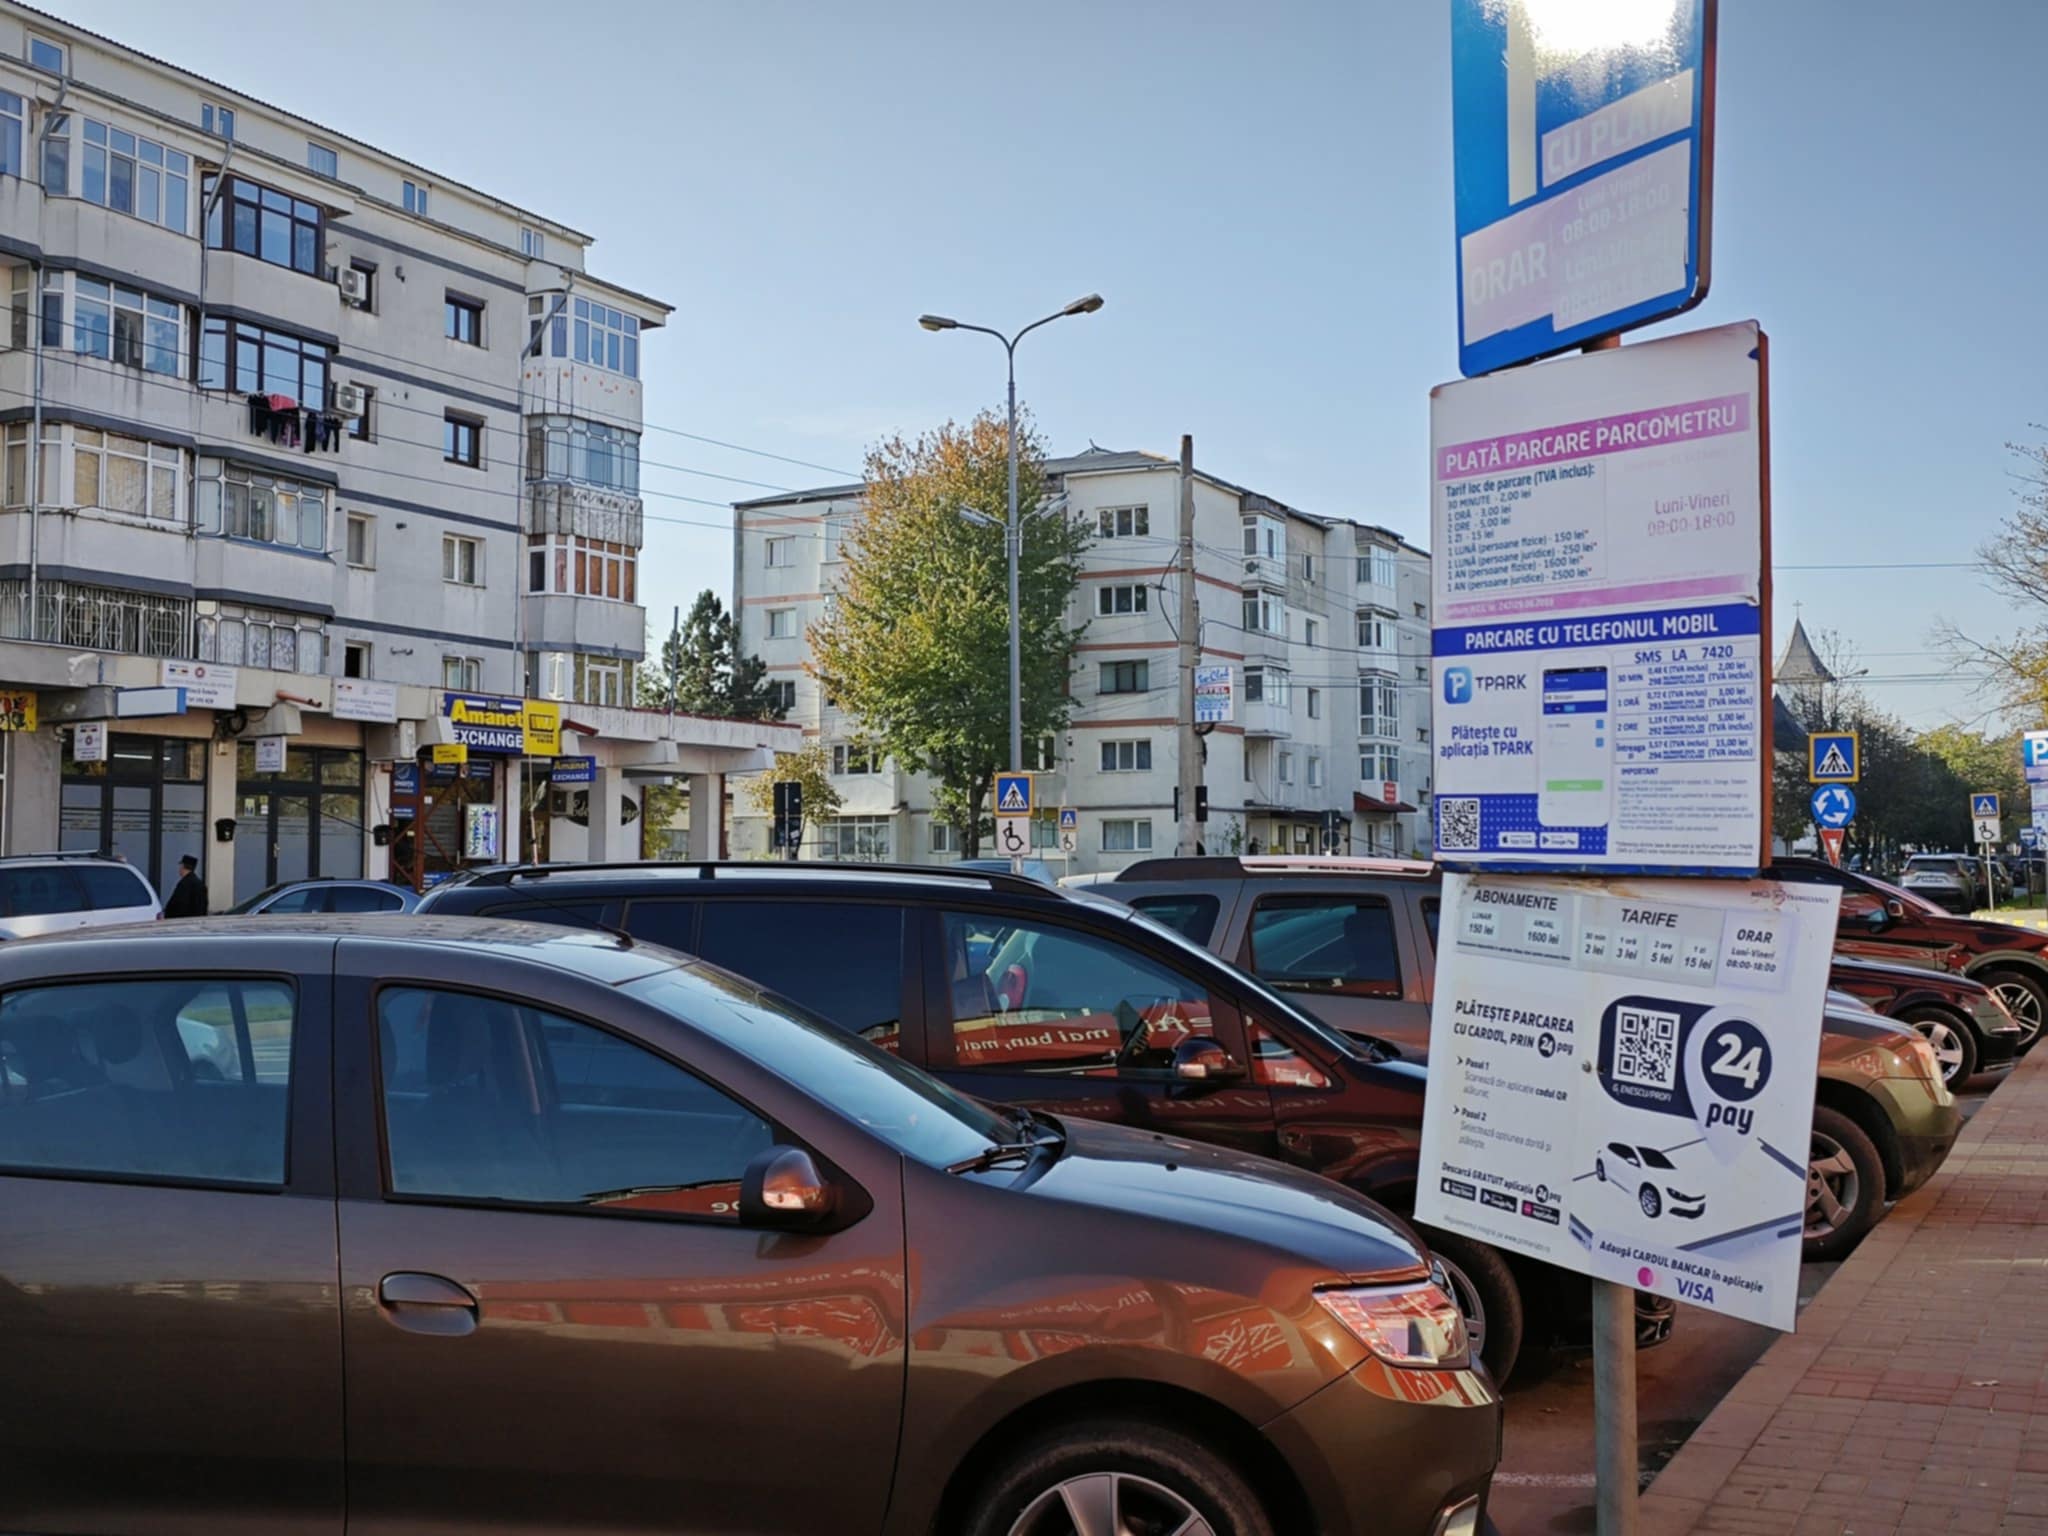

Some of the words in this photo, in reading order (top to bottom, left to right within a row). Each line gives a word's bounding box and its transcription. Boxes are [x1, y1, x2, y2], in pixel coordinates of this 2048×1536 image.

[1548, 132, 1581, 175] CU
[1470, 241, 1548, 306] ORAR
[1446, 441, 1500, 473] PLATĂ
[1504, 430, 1591, 464] PARCARE
[1595, 404, 1737, 449] PARCOMETRU
[1446, 483, 1466, 497] Tarif
[1468, 482, 1481, 494] loc
[1483, 479, 1495, 491] de
[1497, 474, 1532, 492] parcare
[1534, 470, 1557, 486] (TVA
[1559, 463, 1595, 480] inclus):
[1460, 494, 1490, 508] MINUTE
[1521, 489, 1532, 499] lei
[1654, 490, 1730, 515] Luni-Vineri
[1501, 504, 1512, 514] lei
[1454, 521, 1471, 532] ORE
[1500, 516, 1511, 526] lei
[1648, 511, 1735, 536] 08:00-18:00
[1471, 530, 1482, 540] 15
[1484, 528, 1495, 539] lei
[1478, 538, 1519, 554] (persoane
[1554, 531, 1572, 543] 150
[1478, 551, 1519, 567] (persoane
[1468, 564, 1509, 579] (persoane
[1468, 576, 1509, 591] (persoane
[1465, 628, 1534, 650] PARCARE
[1538, 626, 1559, 645] CU
[1563, 618, 1658, 643] TELEFONUL
[1662, 613, 1719, 635] MOBIL
[1634, 650, 1662, 664] SMS
[1672, 648, 1687, 661] LA
[1701, 645, 1733, 659] 7420
[1475, 673, 1527, 691] TPARK
[452, 699, 523, 728] Amanet
[453, 728, 523, 749] EXCHANGE
[1451, 725, 1501, 742] Plătește
[1503, 727, 1518, 738] cu
[1440, 742, 1489, 760] aplicația
[1492, 741, 1534, 755] TPARK
[553, 760, 590, 770] Amanet
[552, 771, 590, 781] EXCHANGE
[1473, 889, 1559, 911] ABONAMENTE
[1621, 908, 1678, 929] TARIFE
[1468, 923, 1483, 934] 150
[1483, 924, 1494, 936] lei
[1528, 931, 1547, 944] 1600
[1548, 933, 1560, 945] lei
[1736, 928, 1773, 944] ORAR
[1584, 944, 1592, 954] 2
[1593, 944, 1604, 956] lei
[1616, 948, 1624, 958] 3
[1624, 948, 1637, 960] lei
[1650, 953, 1658, 963] 5
[1659, 953, 1673, 965] lei
[1731, 946, 1775, 959] Luni-Vineri
[1684, 957, 1697, 968] 15
[1698, 958, 1712, 970] lei
[1726, 959, 1777, 973] 08:00-18:00
[1455, 999, 1511, 1023] PLĂTEȘTE
[1512, 1010, 1575, 1034] PARCAREA
[1453, 1022, 1467, 1035] CU
[1510, 1032, 1536, 1048] PRIN
[1465, 1057, 1485, 1069] Pasul
[1710, 1033, 1763, 1091] 24
[1535, 1087, 1556, 1099] codul
[1556, 1091, 1569, 1102] QR
[1461, 1107, 1480, 1120] Pasul
[1705, 1103, 1754, 1135] pay
[1441, 1161, 1471, 1178] Descarcă
[1471, 1169, 1503, 1187] GRATUIT
[1599, 1241, 1631, 1258] Adaugă
[1632, 1248, 1669, 1268] CARDUL
[1670, 1259, 1711, 1279] BANCAR
[1722, 1274, 1765, 1293] aplicație
[1675, 1277, 1715, 1304] VISA
